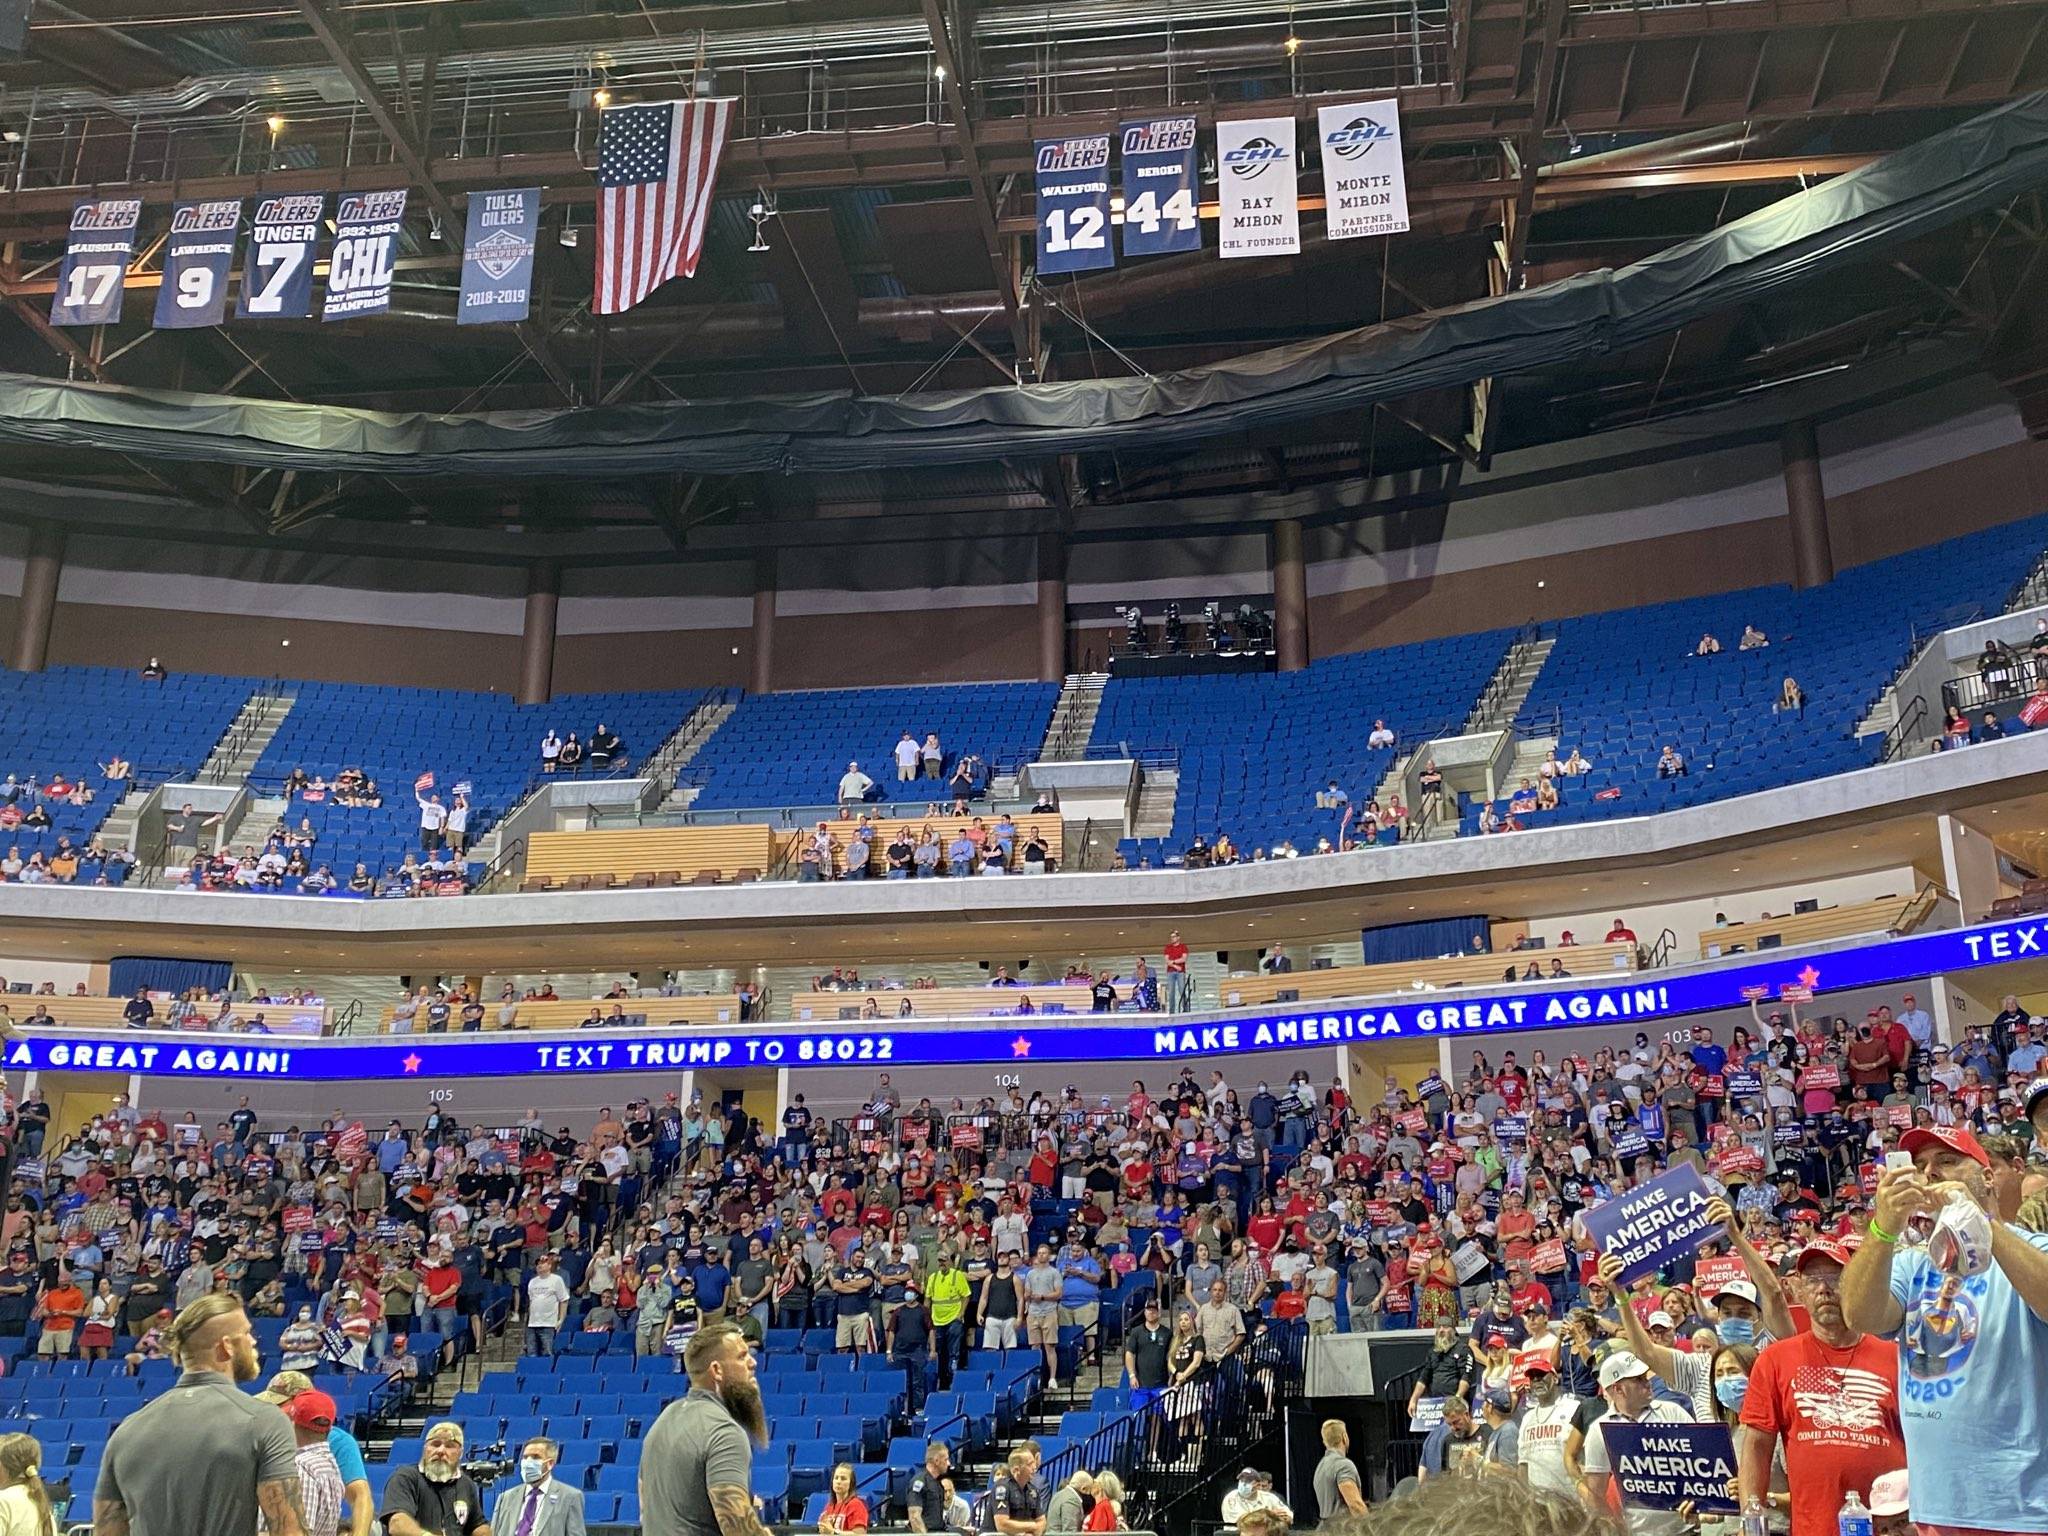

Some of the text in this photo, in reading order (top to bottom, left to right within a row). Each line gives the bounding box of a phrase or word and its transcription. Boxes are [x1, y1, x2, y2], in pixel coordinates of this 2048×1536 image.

[1152, 121, 1194, 133] TULSA
[1326, 127, 1394, 144] CHL
[1065, 139, 1107, 150] TULSA
[1125, 130, 1193, 152] OILERS
[1039, 148, 1106, 170] OILERS
[1223, 147, 1290, 162] CHL
[1041, 183, 1107, 197] WAKEFORD
[1336, 175, 1392, 192] MONTE
[485, 194, 524, 211] TULSA
[1241, 197, 1274, 210] RAY
[1340, 193, 1391, 209] MIRON
[74, 208, 136, 228] OILERS
[175, 208, 235, 229] OILERS
[258, 203, 319, 222] OILERS
[341, 201, 401, 221] OILERS
[481, 210, 525, 227] OILERS
[1126, 189, 1198, 234] 44
[1233, 214, 1283, 228] MIRON
[1341, 213, 1393, 227] PARTNER
[254, 225, 316, 243] UNGER
[1046, 206, 1106, 253] 12
[1329, 221, 1408, 238] COMMISSIONER
[171, 244, 232, 257] LAWRENCE
[1222, 237, 1296, 249] CHL FOUNDER
[329, 236, 393, 292] CHL
[63, 265, 122, 307] 17
[248, 243, 306, 312] 7
[177, 267, 214, 308] 9
[324, 295, 389, 314] CHAMPIONS
[466, 289, 526, 307] 2018-2019
[1963, 924, 2048, 961] TEX
[1953, 996, 1966, 1011] 103
[1155, 987, 1669, 1053] MAKE AMERICA GREAT AGAIN!
[1664, 1028, 1691, 1044] 103
[49, 1045, 159, 1068] GREAT
[172, 1049, 290, 1073] AGAIN!
[537, 1038, 893, 1067] TEXT TRUMP TO 88022
[994, 1074, 1020, 1087] 104
[1806, 1072, 1836, 1080] AMERICA
[428, 1089, 453, 1101] 105
[1616, 1136, 1646, 1148] AMERICA
[1621, 1188, 1668, 1220] MAKE
[1605, 1191, 1708, 1255] AMERICA
[1617, 1236, 1668, 1269] GREAT
[1700, 1269, 1747, 1282] AMERICA
[1711, 1263, 1733, 1271] MAKE
[1488, 1324, 1515, 1332] TRUMP
[1527, 1424, 1563, 1440] TRUMP
[1823, 1430, 1847, 1439] AND
[1849, 1432, 1880, 1444] TAKE
[1642, 1438, 1692, 1453] MAKE
[1619, 1455, 1732, 1478] AMERICA
[1623, 1479, 1676, 1495] GREAT
